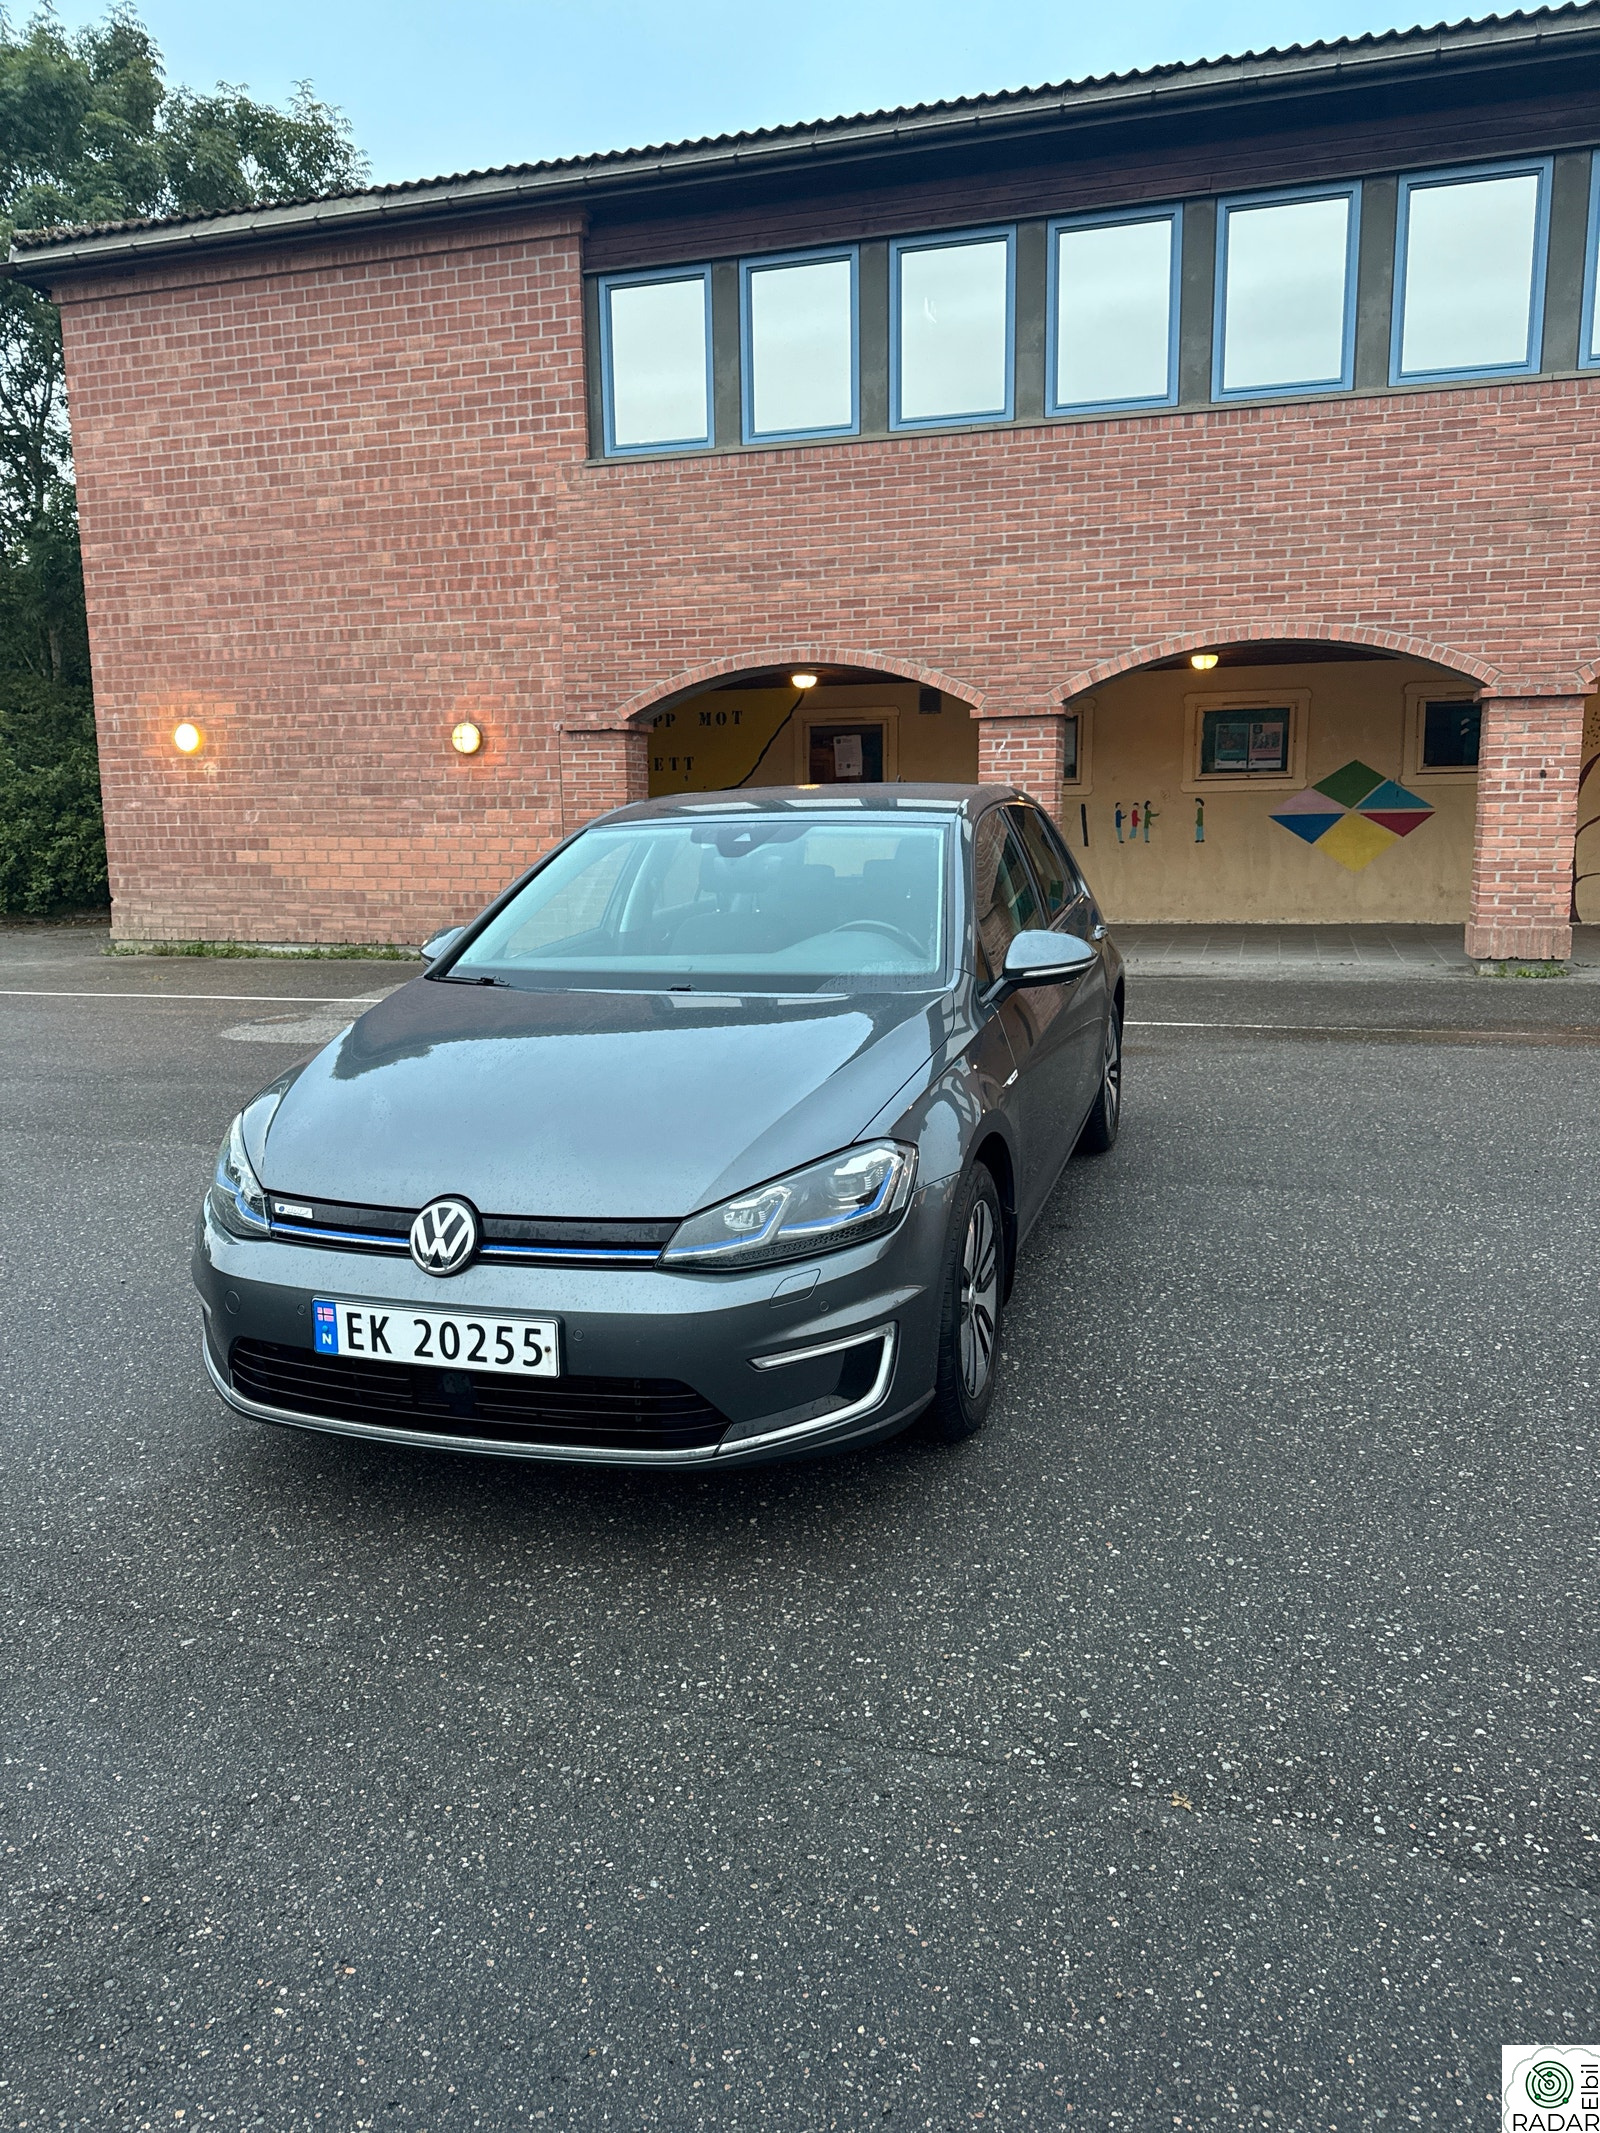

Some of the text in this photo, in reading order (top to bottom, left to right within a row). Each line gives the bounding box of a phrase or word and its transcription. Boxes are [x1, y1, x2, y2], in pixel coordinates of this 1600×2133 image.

[698, 710, 743, 727] MOT
[647, 756, 694, 772] ETT
[321, 1333, 332, 1345] N
[346, 1311, 543, 1367] EK 20255
